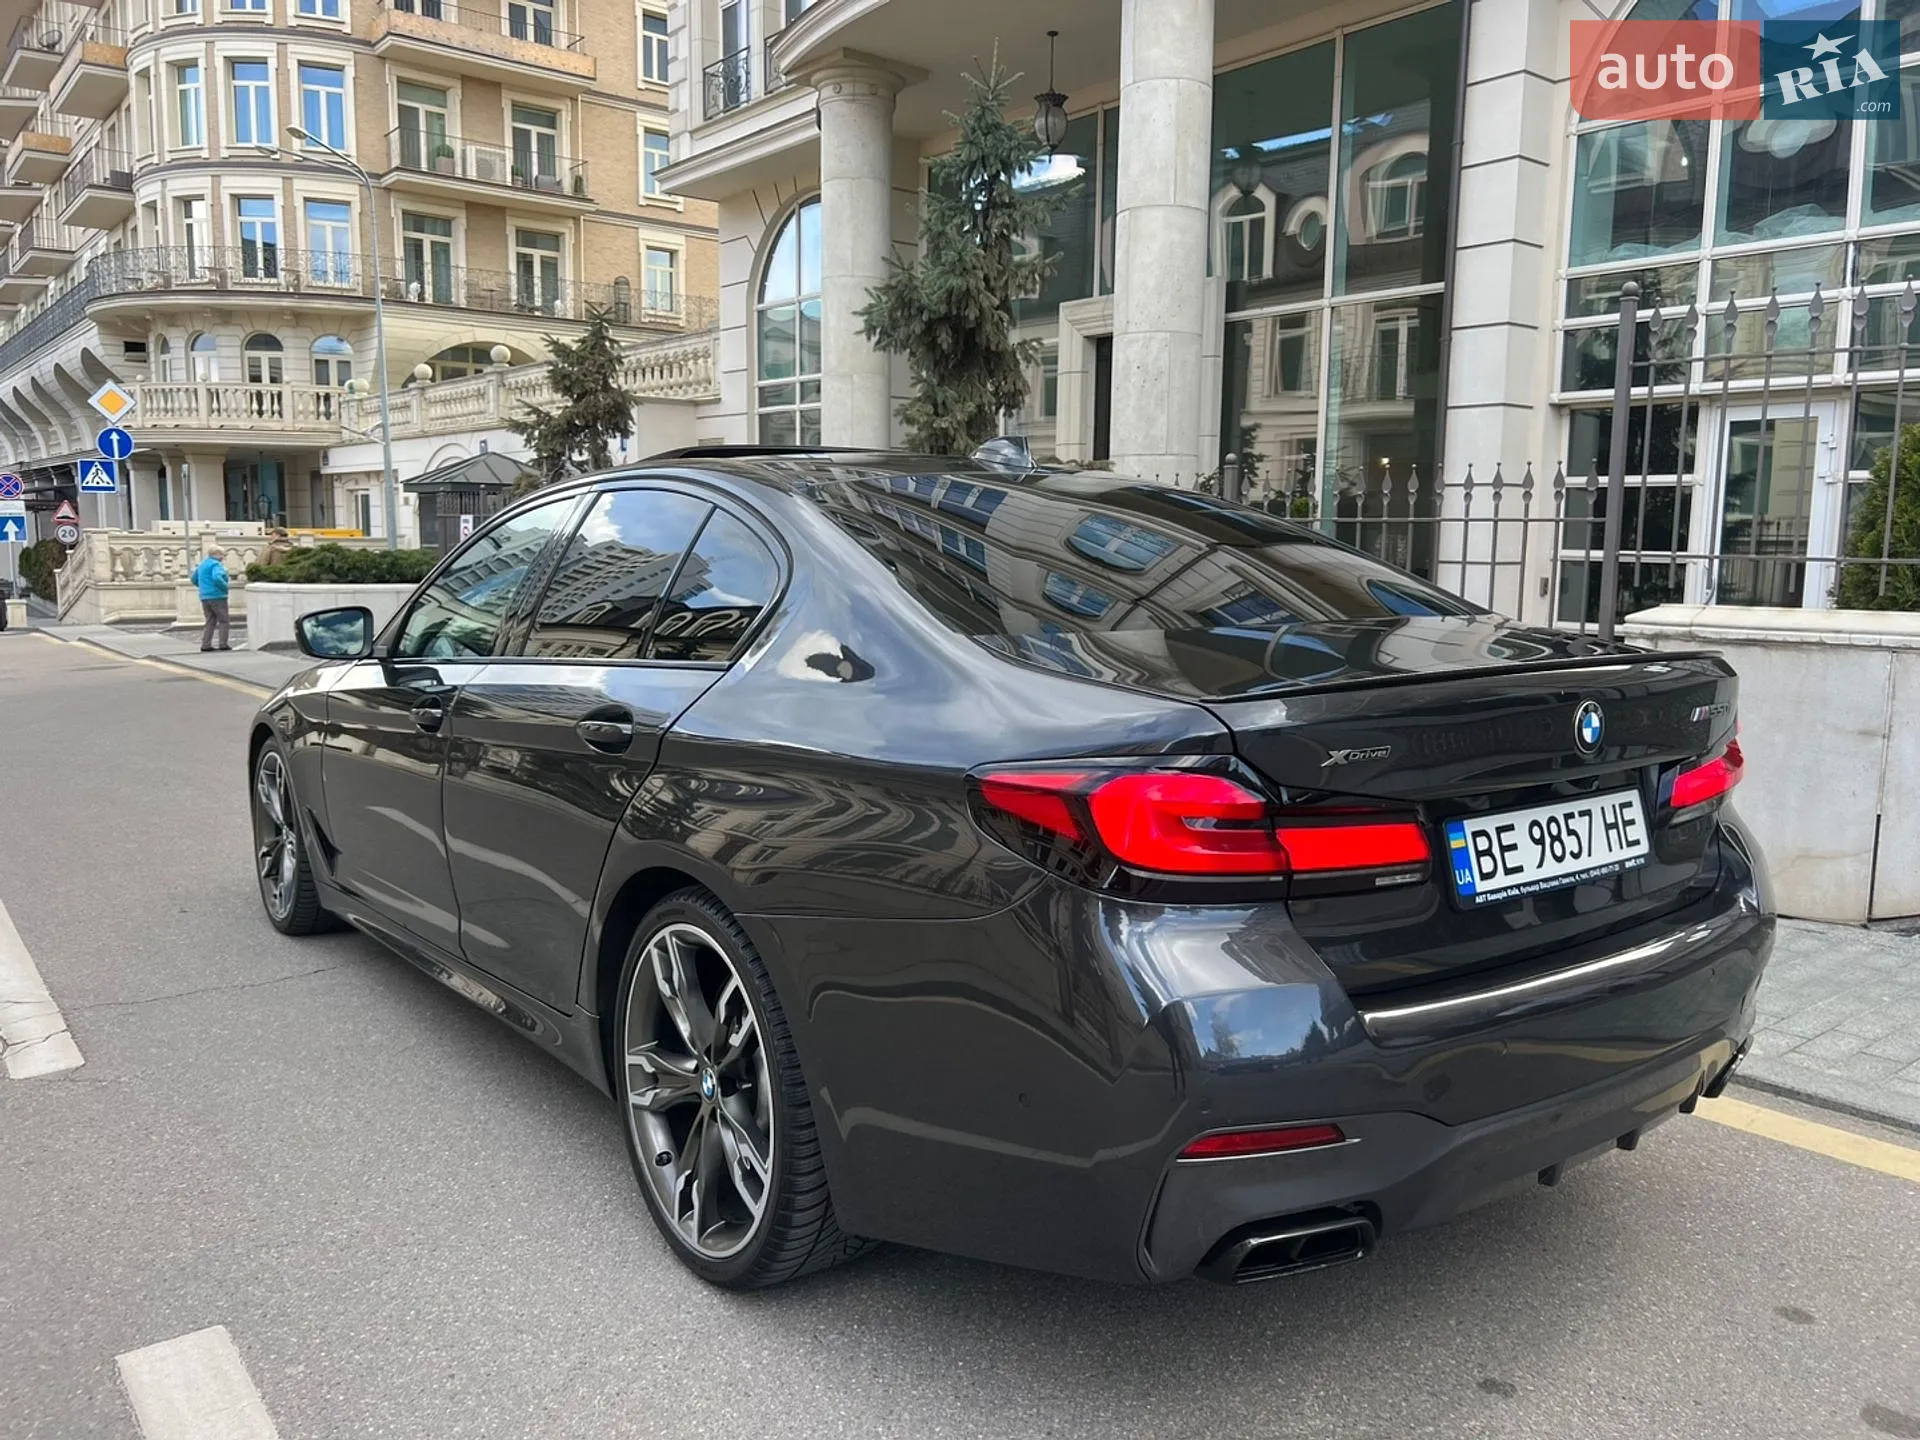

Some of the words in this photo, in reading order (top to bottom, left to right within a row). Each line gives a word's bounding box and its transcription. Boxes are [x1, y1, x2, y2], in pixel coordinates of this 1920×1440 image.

[61, 529, 75, 538] 20
[1471, 823, 1524, 882] BE
[1528, 808, 1593, 869] 9857
[1600, 801, 1641, 853] HE
[1455, 869, 1473, 885] UA
